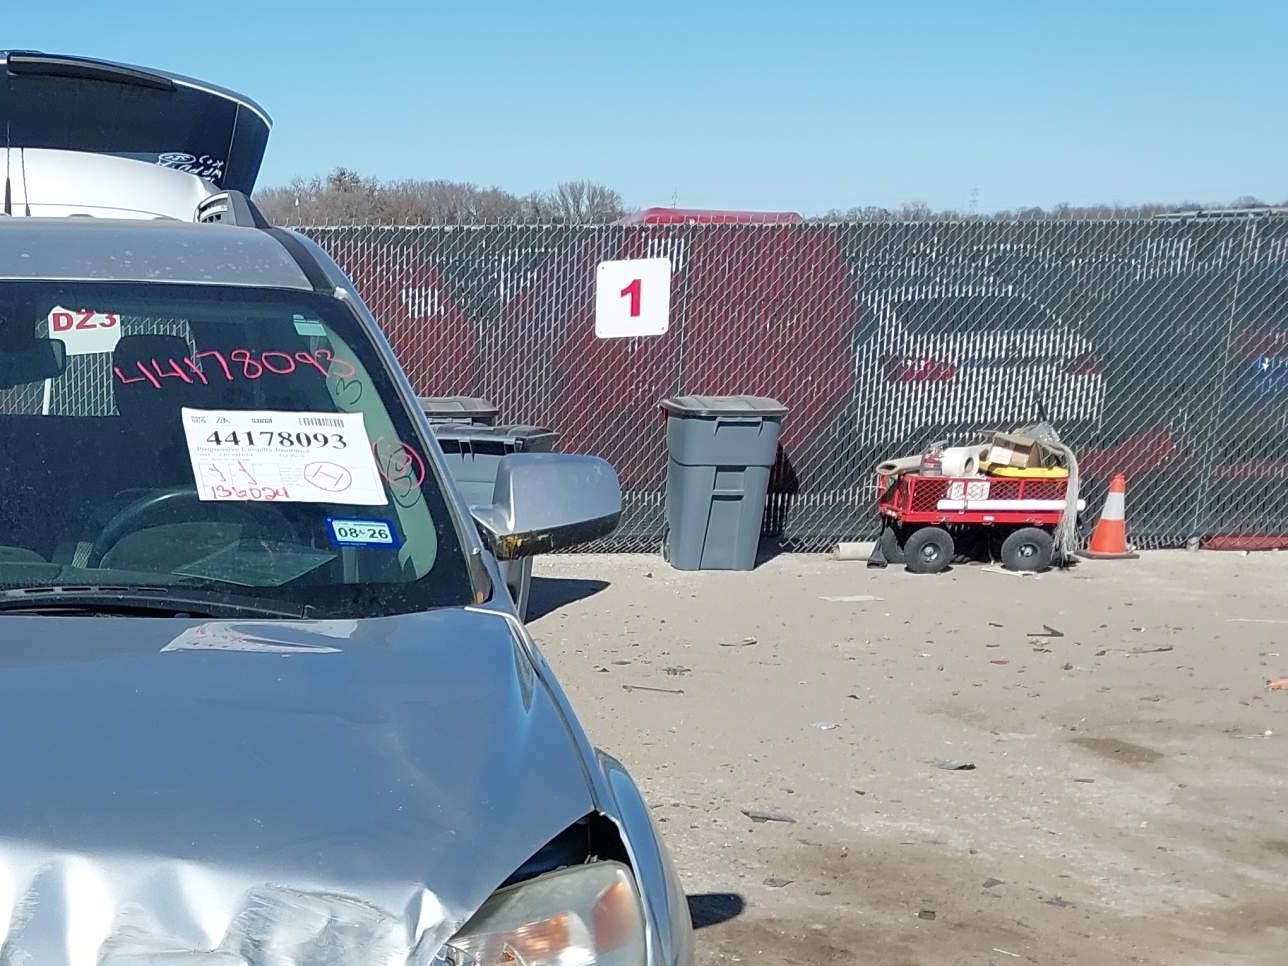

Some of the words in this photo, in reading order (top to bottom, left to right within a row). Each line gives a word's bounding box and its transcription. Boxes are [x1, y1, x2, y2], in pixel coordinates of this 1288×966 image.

[620, 279, 642, 317] 1
[114, 349, 355, 389] 44178093
[206, 430, 347, 450] 44178093
[338, 527, 359, 538] 08
[367, 528, 389, 540] 26
